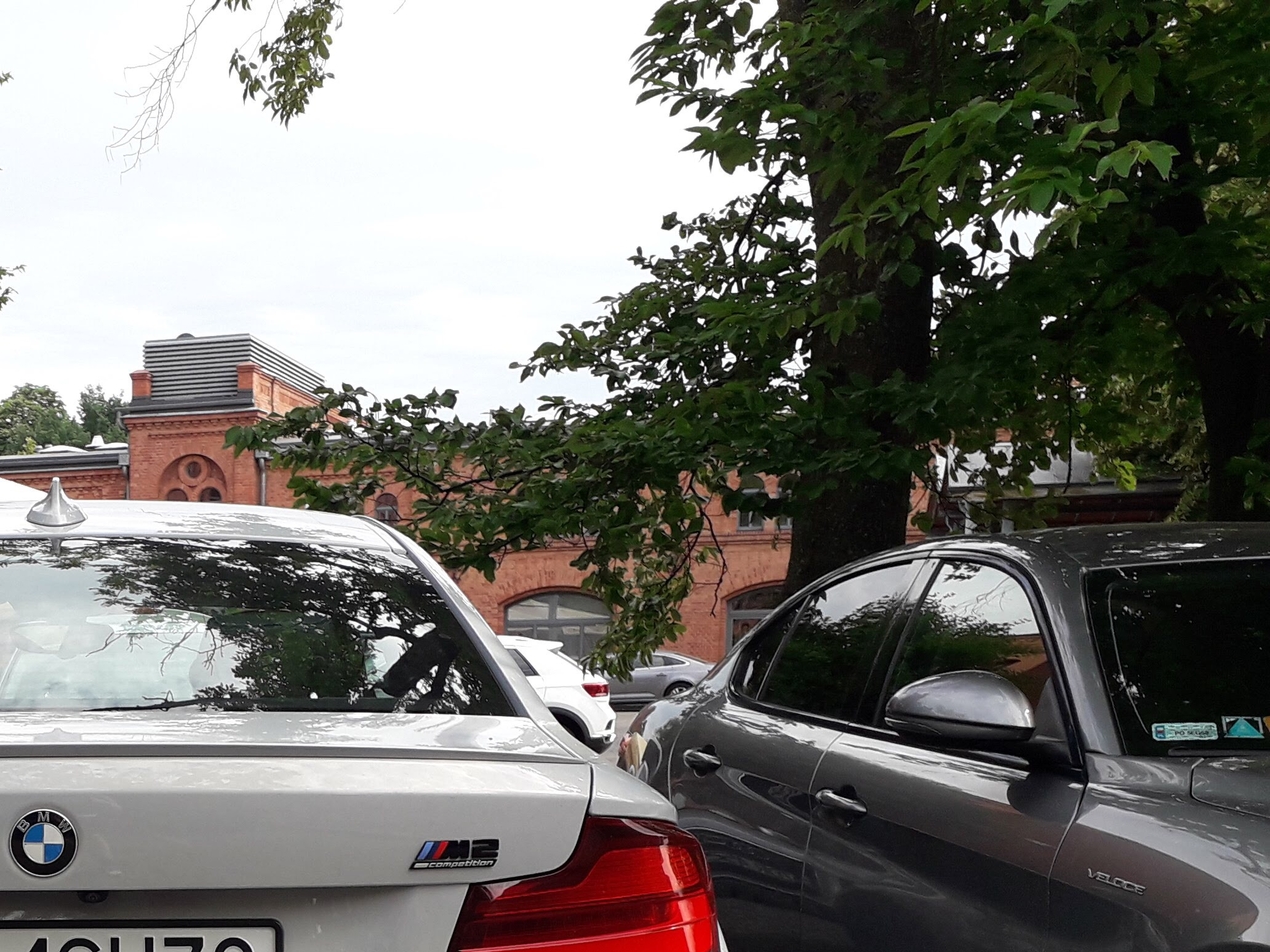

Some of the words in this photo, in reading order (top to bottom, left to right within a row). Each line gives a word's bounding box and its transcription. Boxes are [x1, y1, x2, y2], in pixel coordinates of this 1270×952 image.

[16, 811, 72, 834] BMW
[434, 838, 500, 860] M2
[428, 859, 494, 869] competition
[1087, 867, 1147, 896] VELOCE
